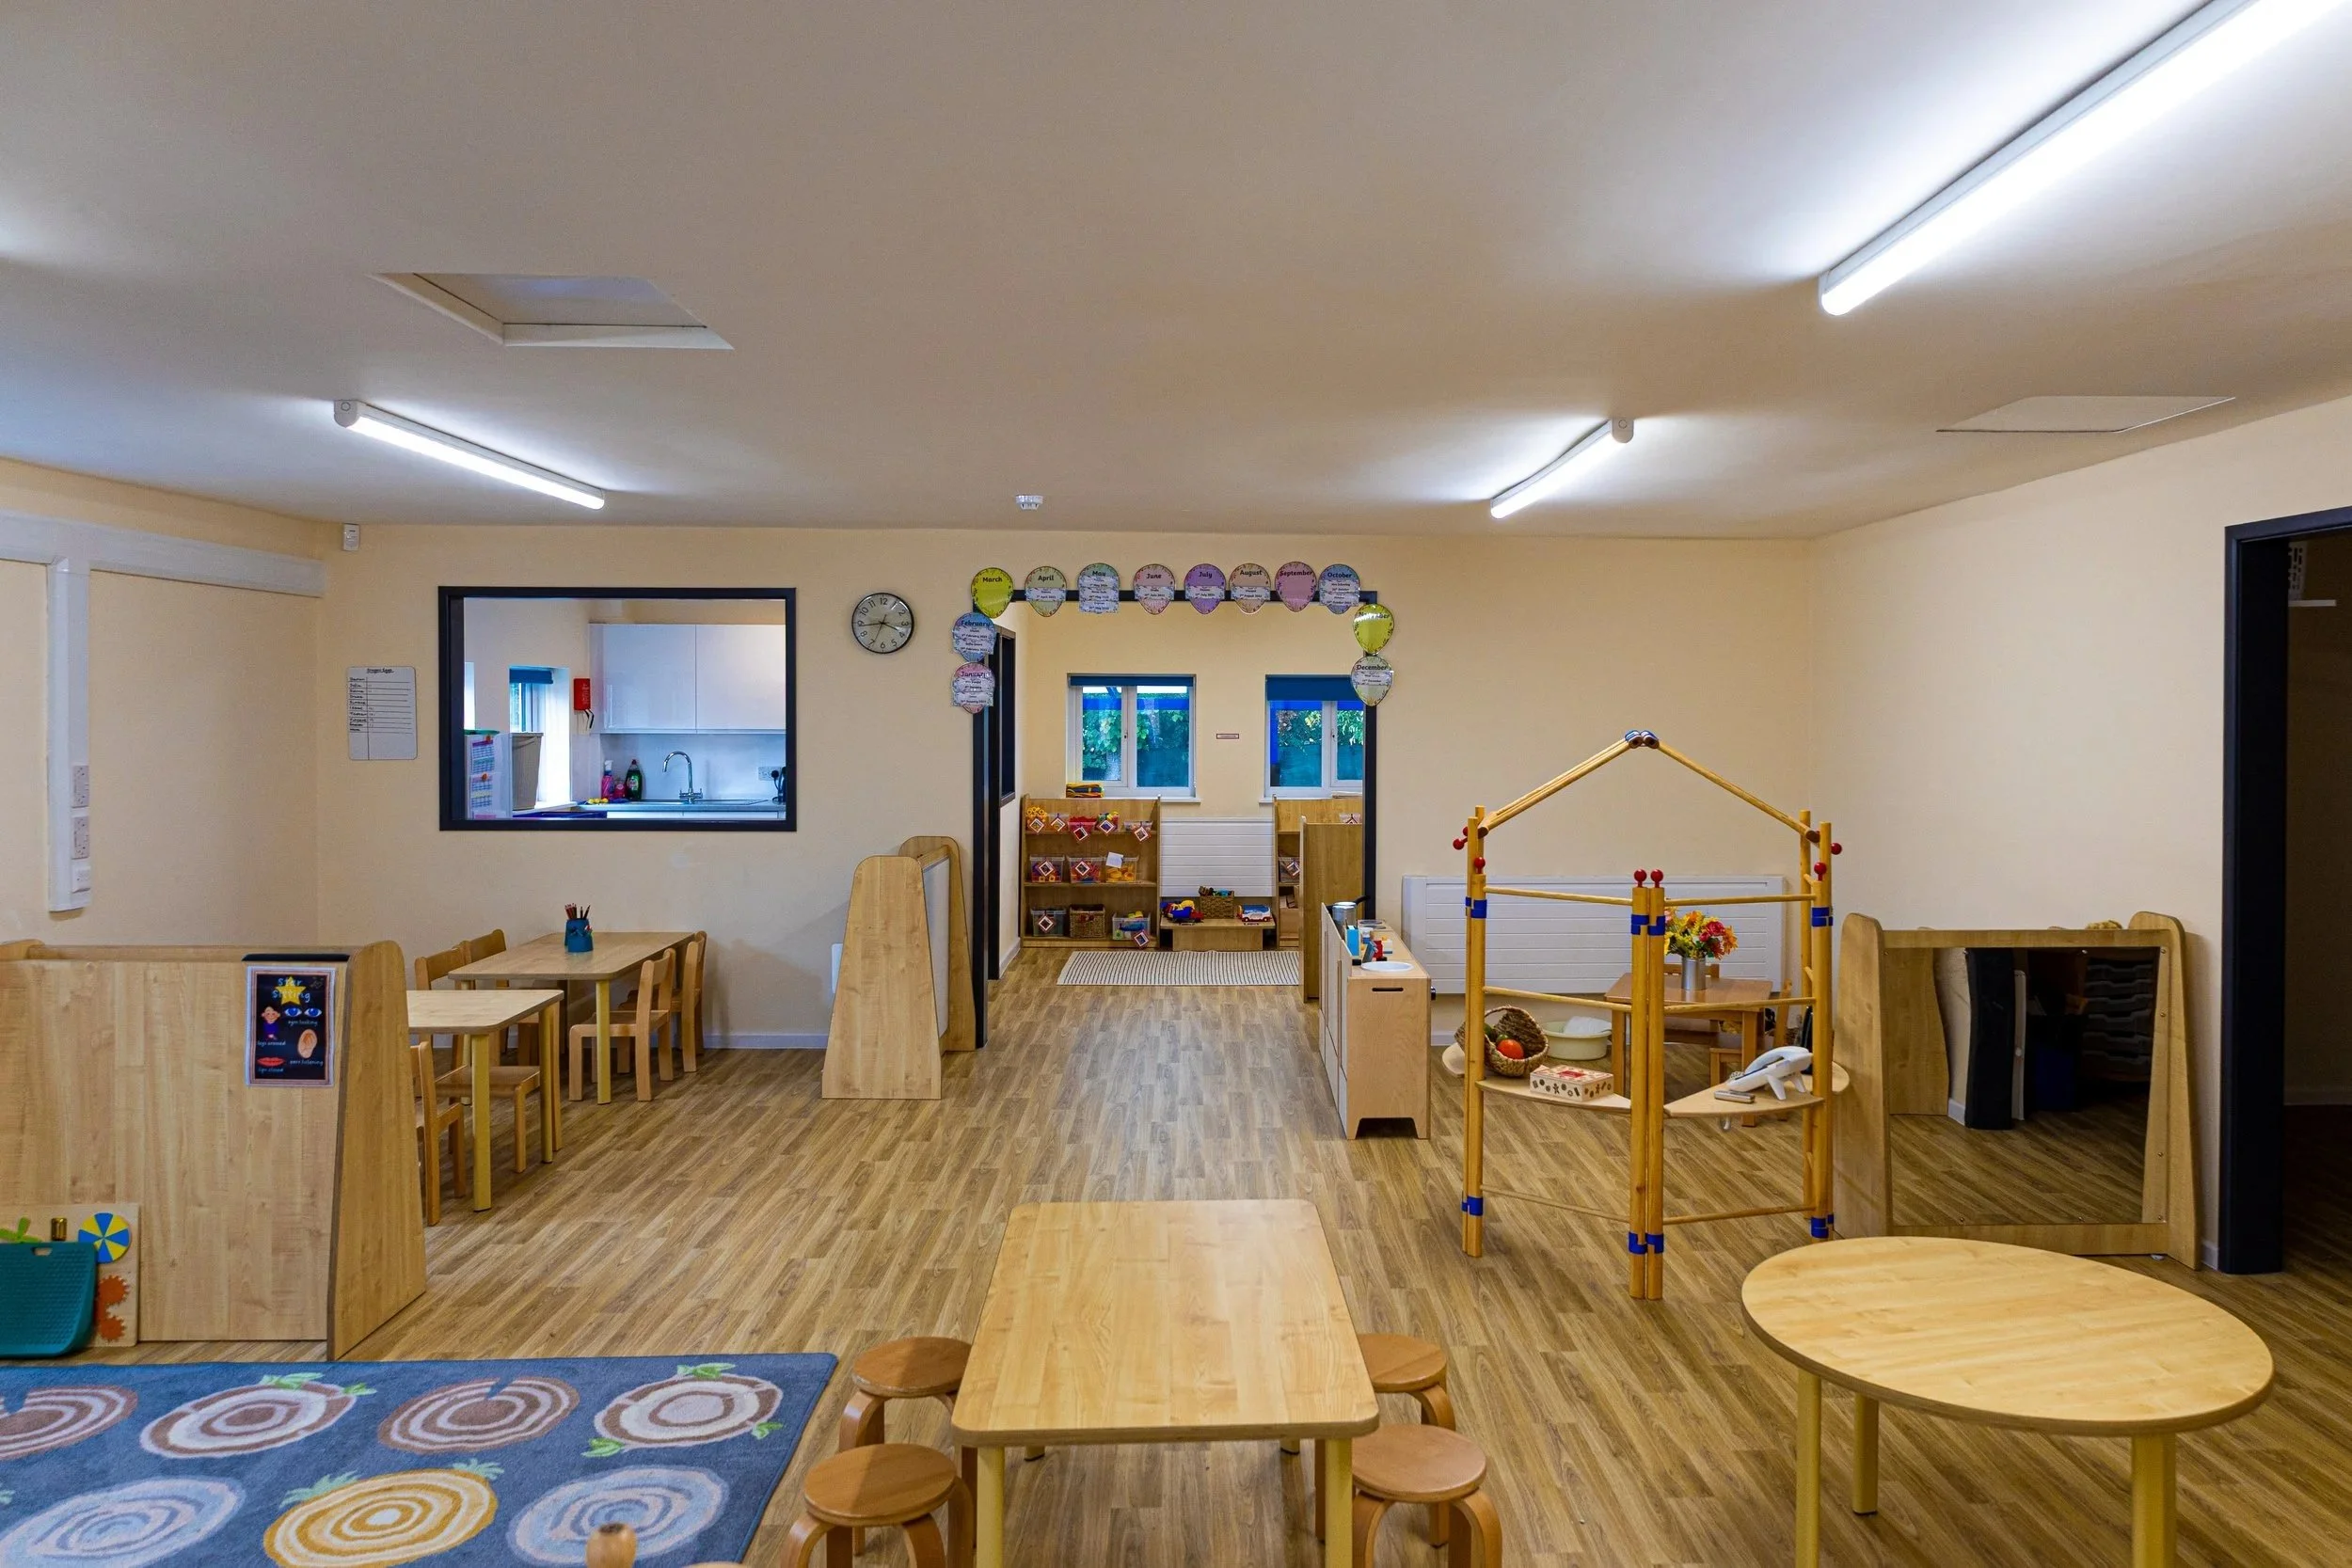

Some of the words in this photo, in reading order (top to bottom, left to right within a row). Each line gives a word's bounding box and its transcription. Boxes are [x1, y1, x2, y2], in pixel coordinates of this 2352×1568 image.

[868, 599, 876, 608] 11
[860, 607, 868, 616] 10
[278, 977, 302, 986] Star
